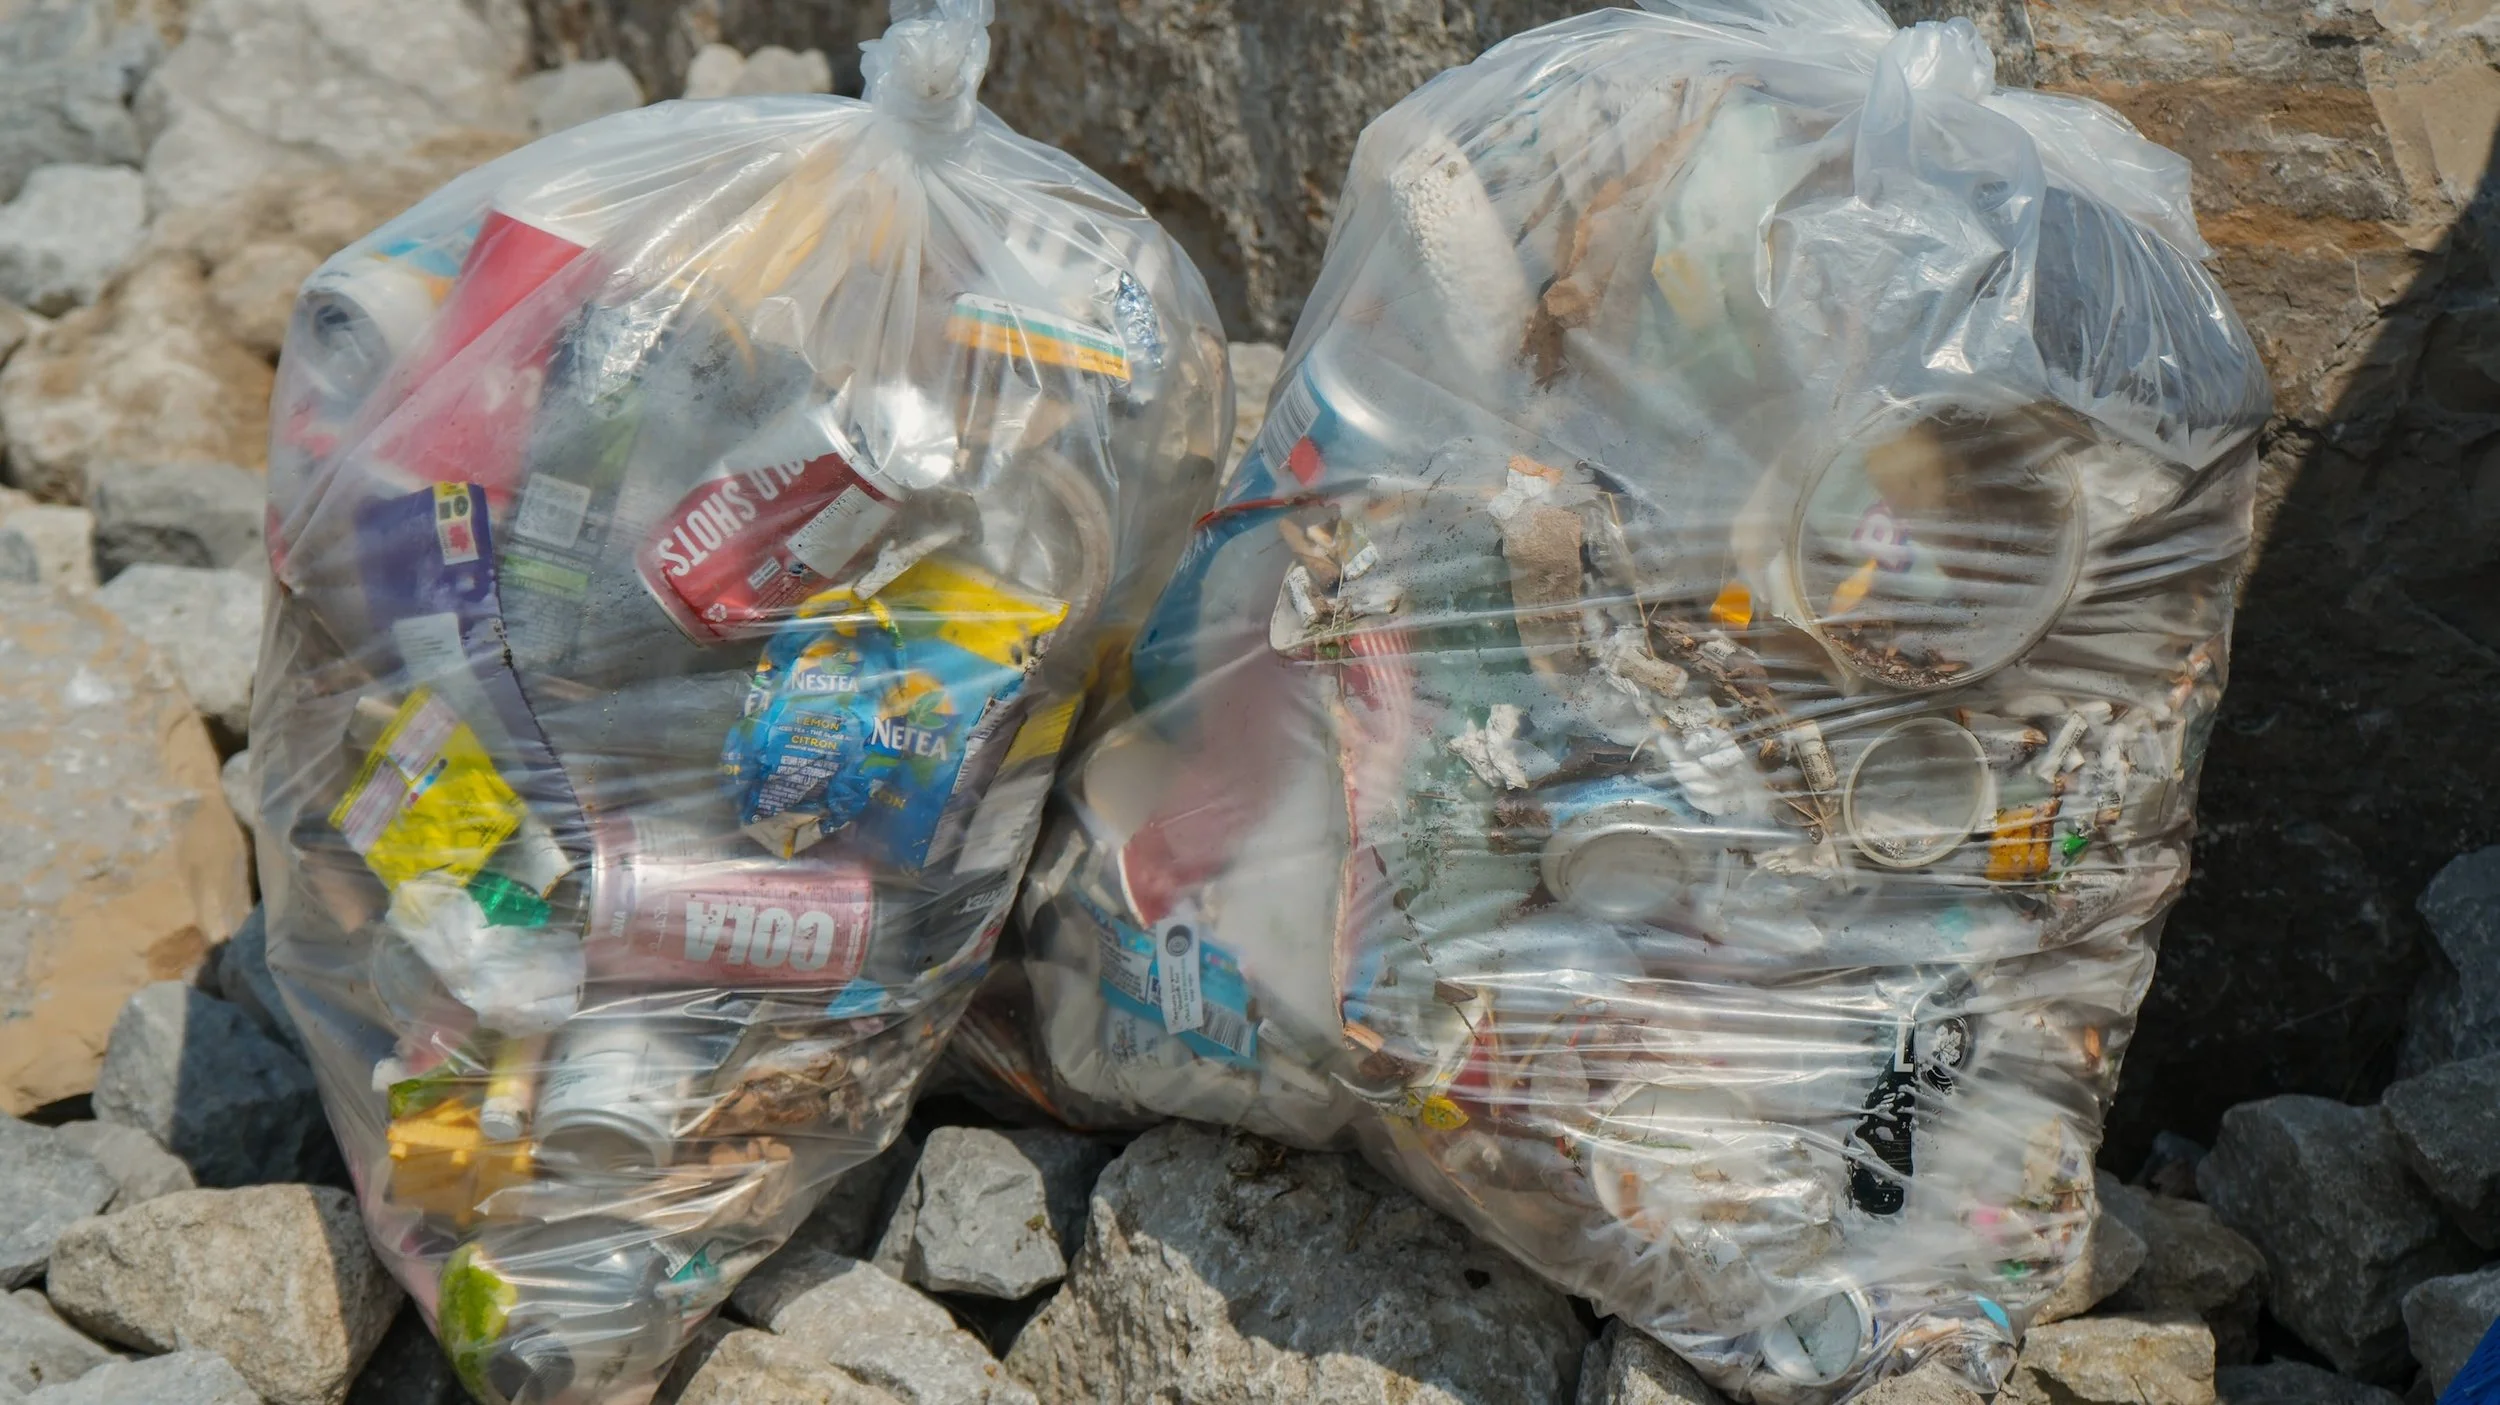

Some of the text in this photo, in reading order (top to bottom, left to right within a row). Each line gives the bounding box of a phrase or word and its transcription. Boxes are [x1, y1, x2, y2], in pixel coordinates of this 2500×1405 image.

[657, 481, 757, 577] SHOTS
[791, 672, 859, 693] NESTEA
[796, 715, 840, 731] LEMON
[791, 735, 838, 750] CITRON
[684, 900, 835, 972] COLA
